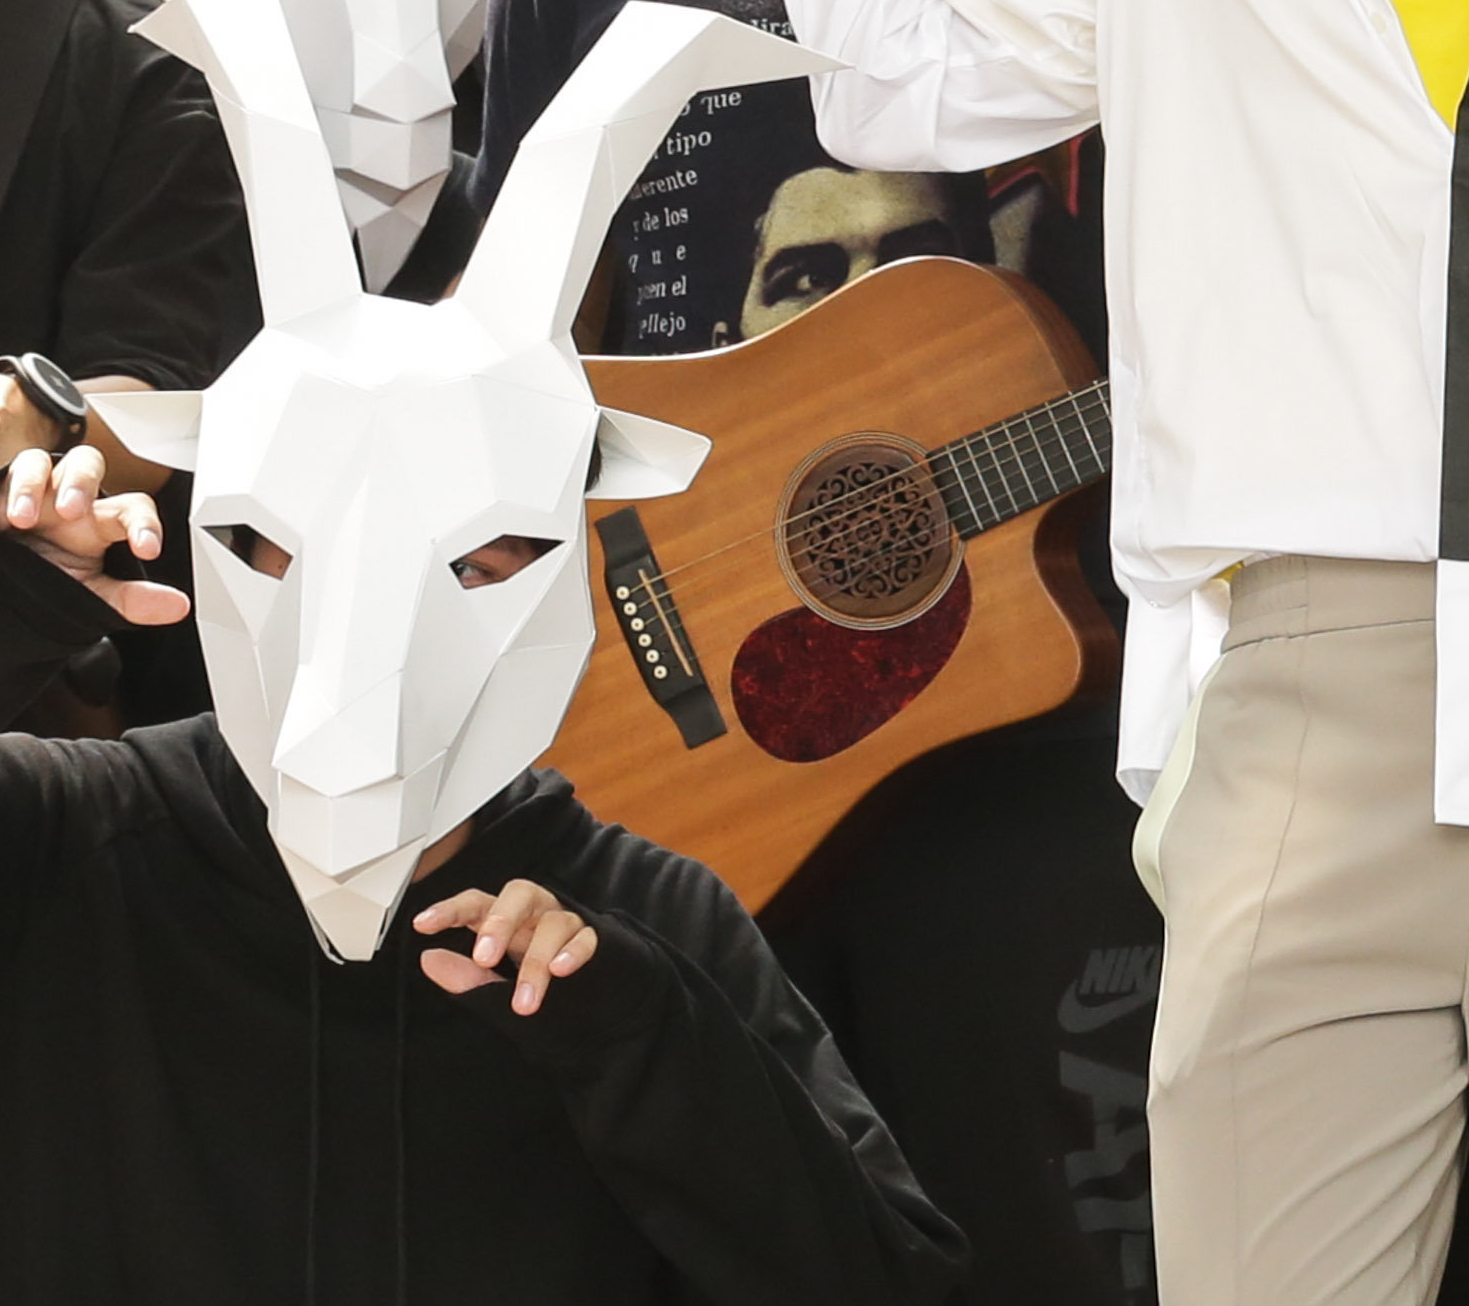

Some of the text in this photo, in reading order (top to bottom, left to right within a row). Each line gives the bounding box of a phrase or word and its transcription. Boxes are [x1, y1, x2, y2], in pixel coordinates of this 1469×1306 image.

[700, 91, 742, 115] que
[666, 130, 712, 156] tipo
[663, 207, 689, 227] los
[671, 275, 687, 296] el
